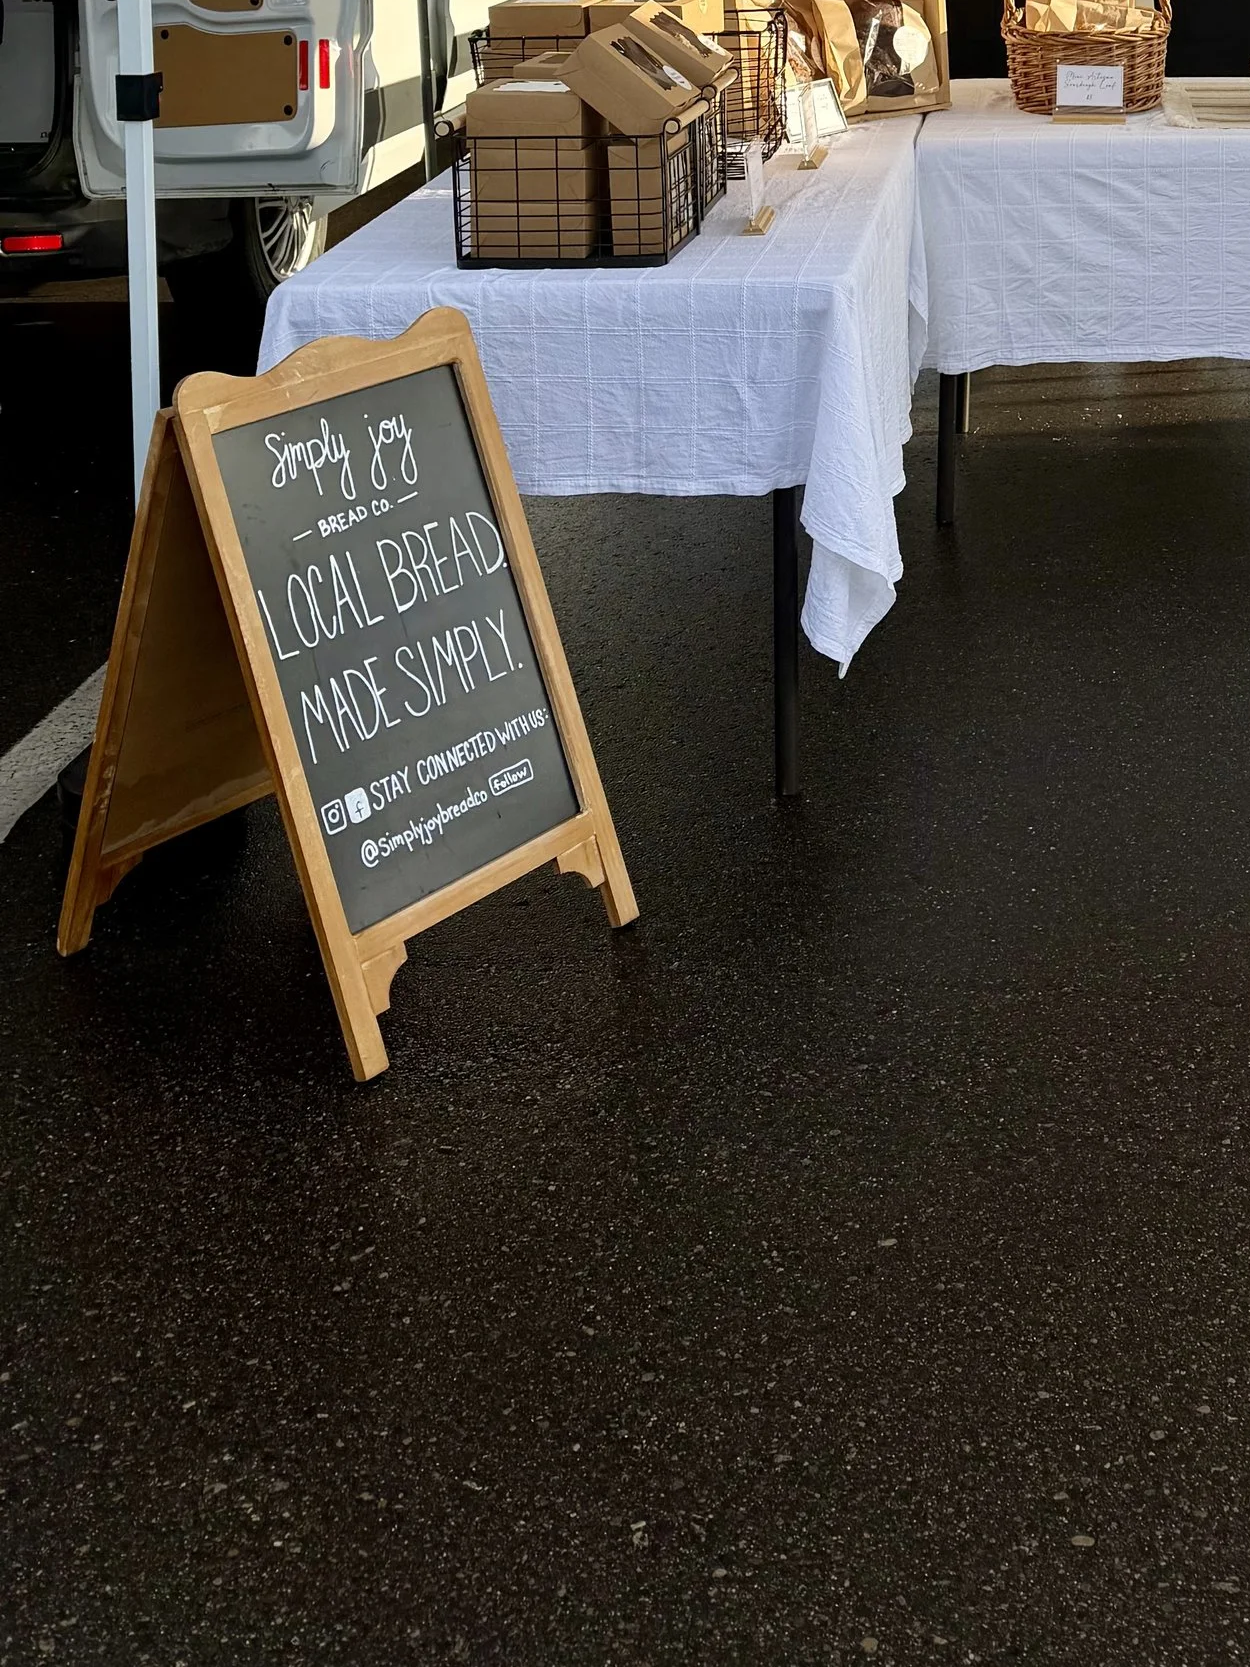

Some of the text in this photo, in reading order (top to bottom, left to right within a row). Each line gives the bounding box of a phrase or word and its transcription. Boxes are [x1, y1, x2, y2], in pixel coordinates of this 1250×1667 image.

[265, 413, 418, 500] Simply joy
[317, 498, 394, 538] BREAD CO.
[258, 511, 509, 660] LOCAL BREAD.
[301, 609, 524, 764] MADE SIMPLY.
[370, 707, 550, 811] STAY CONNECTED WITH US:
[361, 766, 528, 868] @simplyjoybreadco follow
